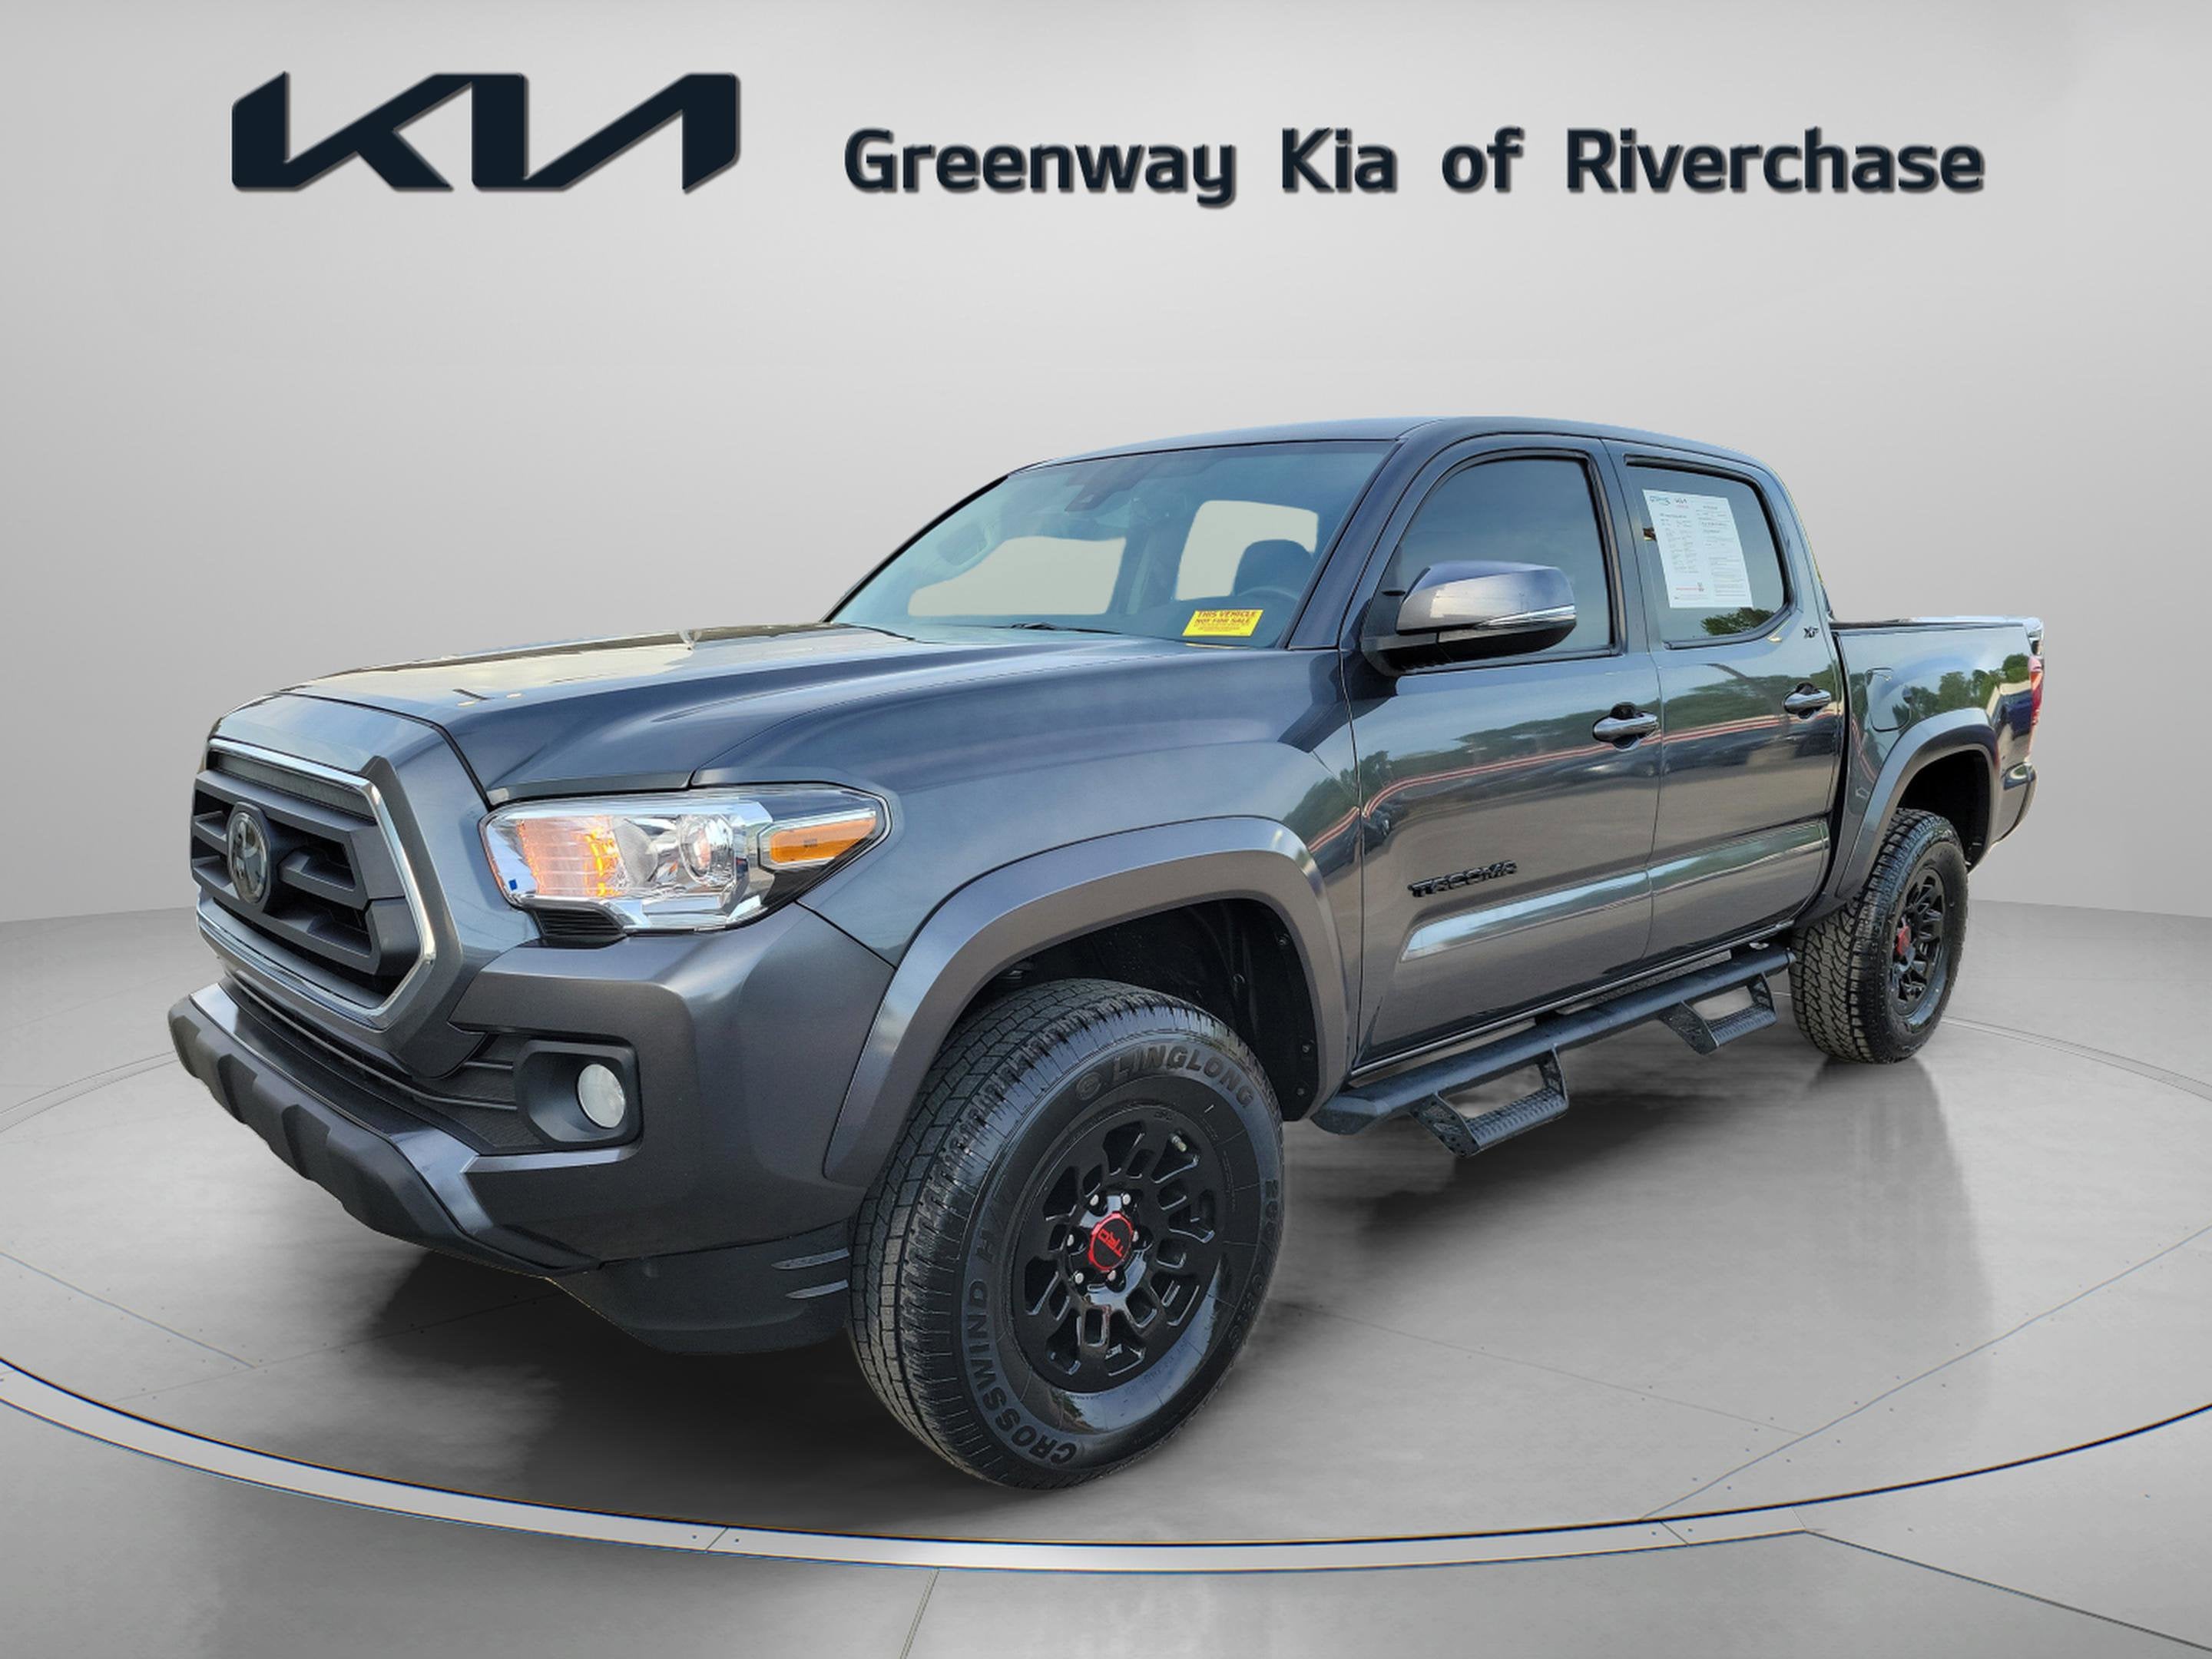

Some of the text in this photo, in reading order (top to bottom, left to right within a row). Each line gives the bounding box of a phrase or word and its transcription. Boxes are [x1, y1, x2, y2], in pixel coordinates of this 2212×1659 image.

[1407, 859, 1518, 898] TACOMA
[1113, 1045, 1255, 1109] LINGLONG
[966, 1279, 1077, 1465] CROSSWIND
